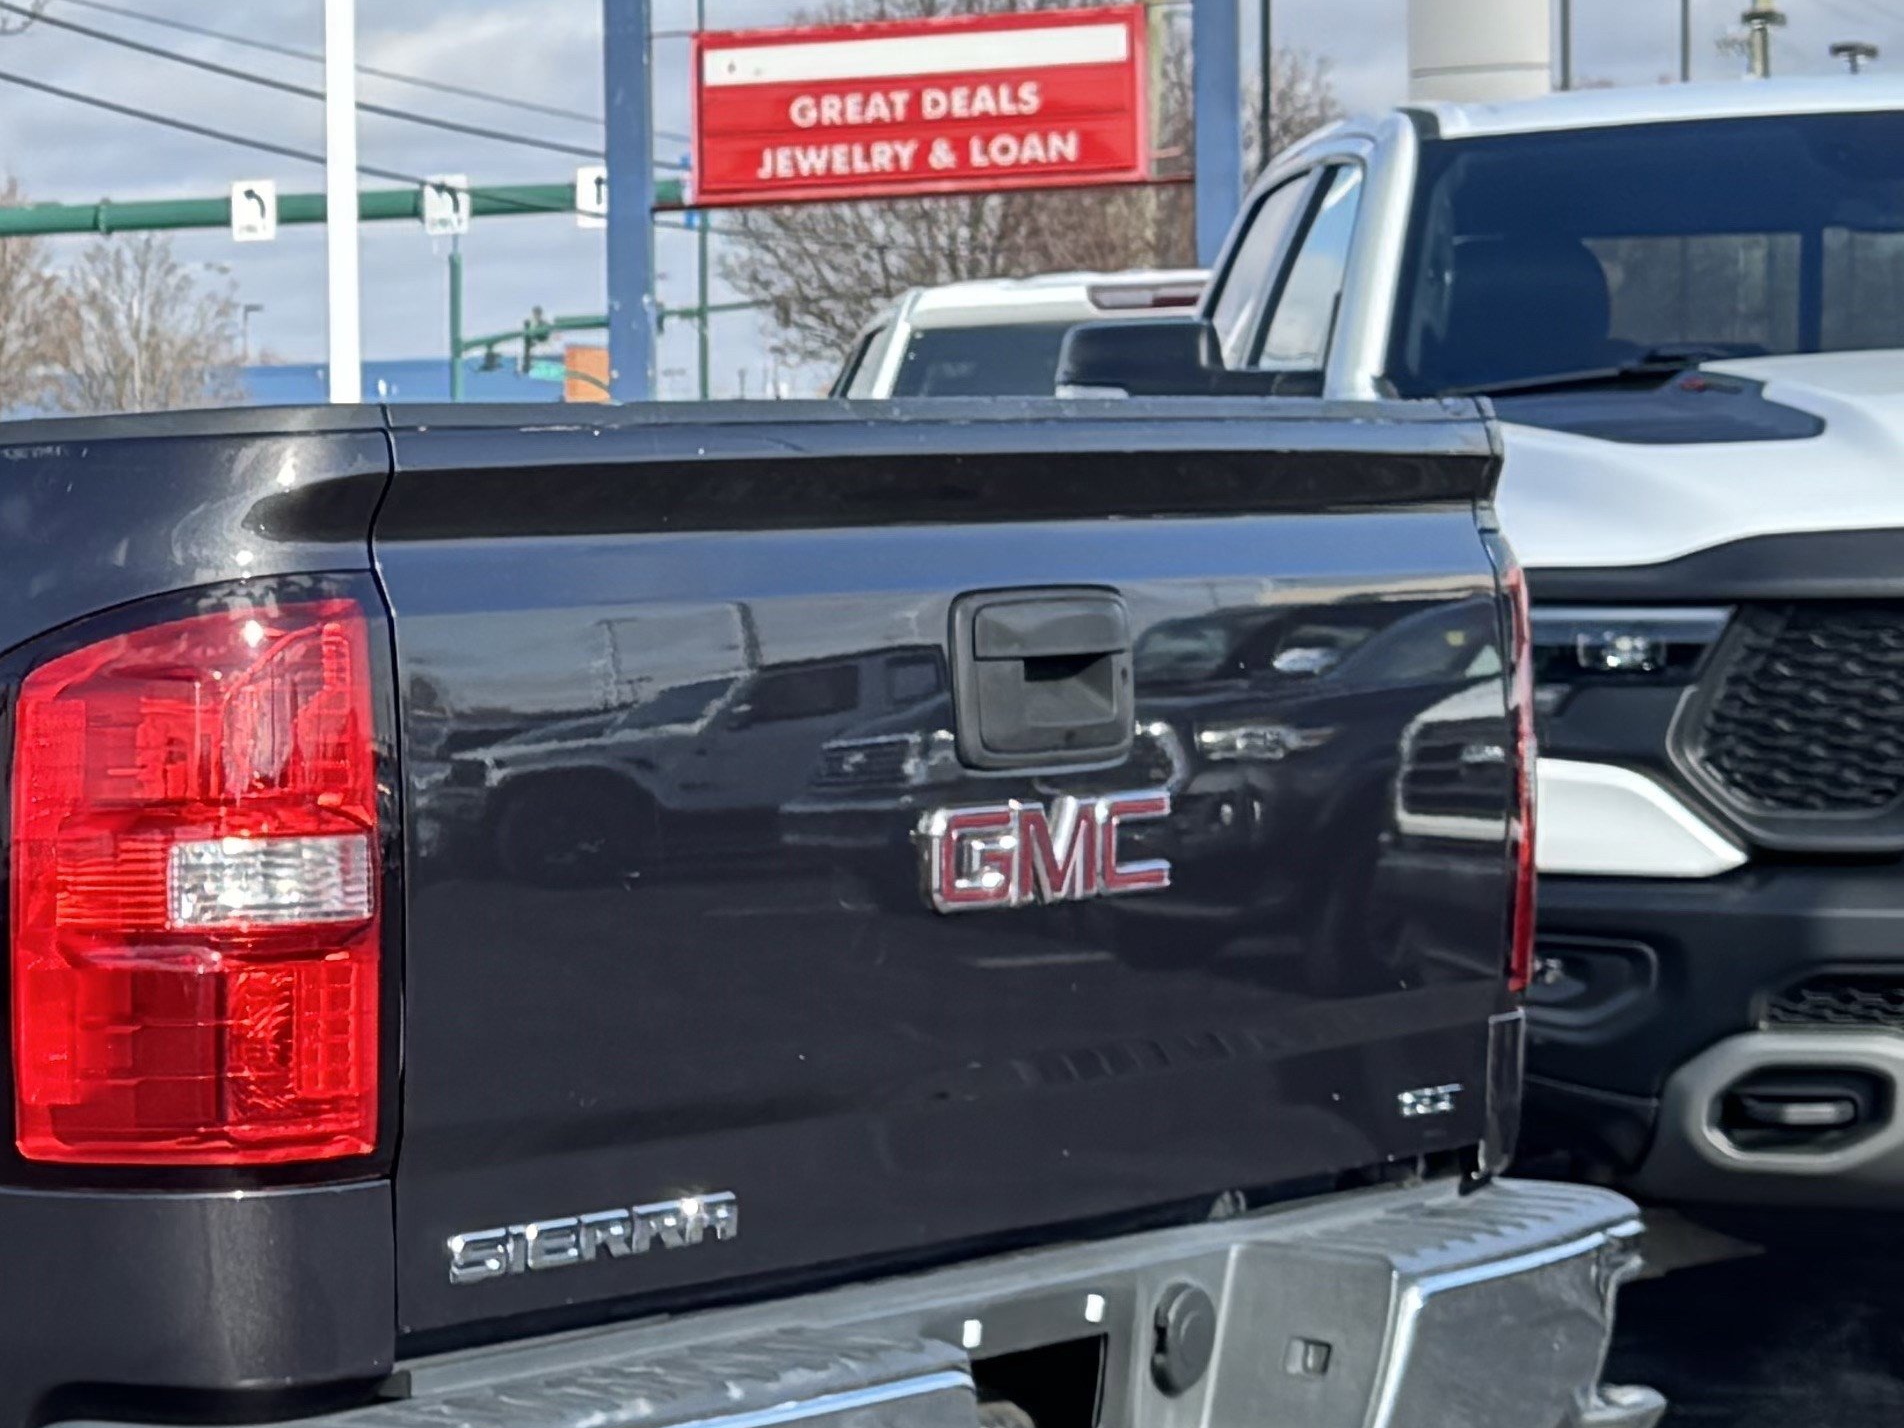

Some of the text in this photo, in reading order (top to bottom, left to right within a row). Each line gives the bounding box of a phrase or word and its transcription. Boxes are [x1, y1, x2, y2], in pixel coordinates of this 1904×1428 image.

[789, 80, 1040, 128] GREAT DEALS
[756, 130, 1080, 180] JEWELRY & LOAN
[930, 791, 1172, 914] GMC
[447, 1190, 739, 1284] SIERRA
